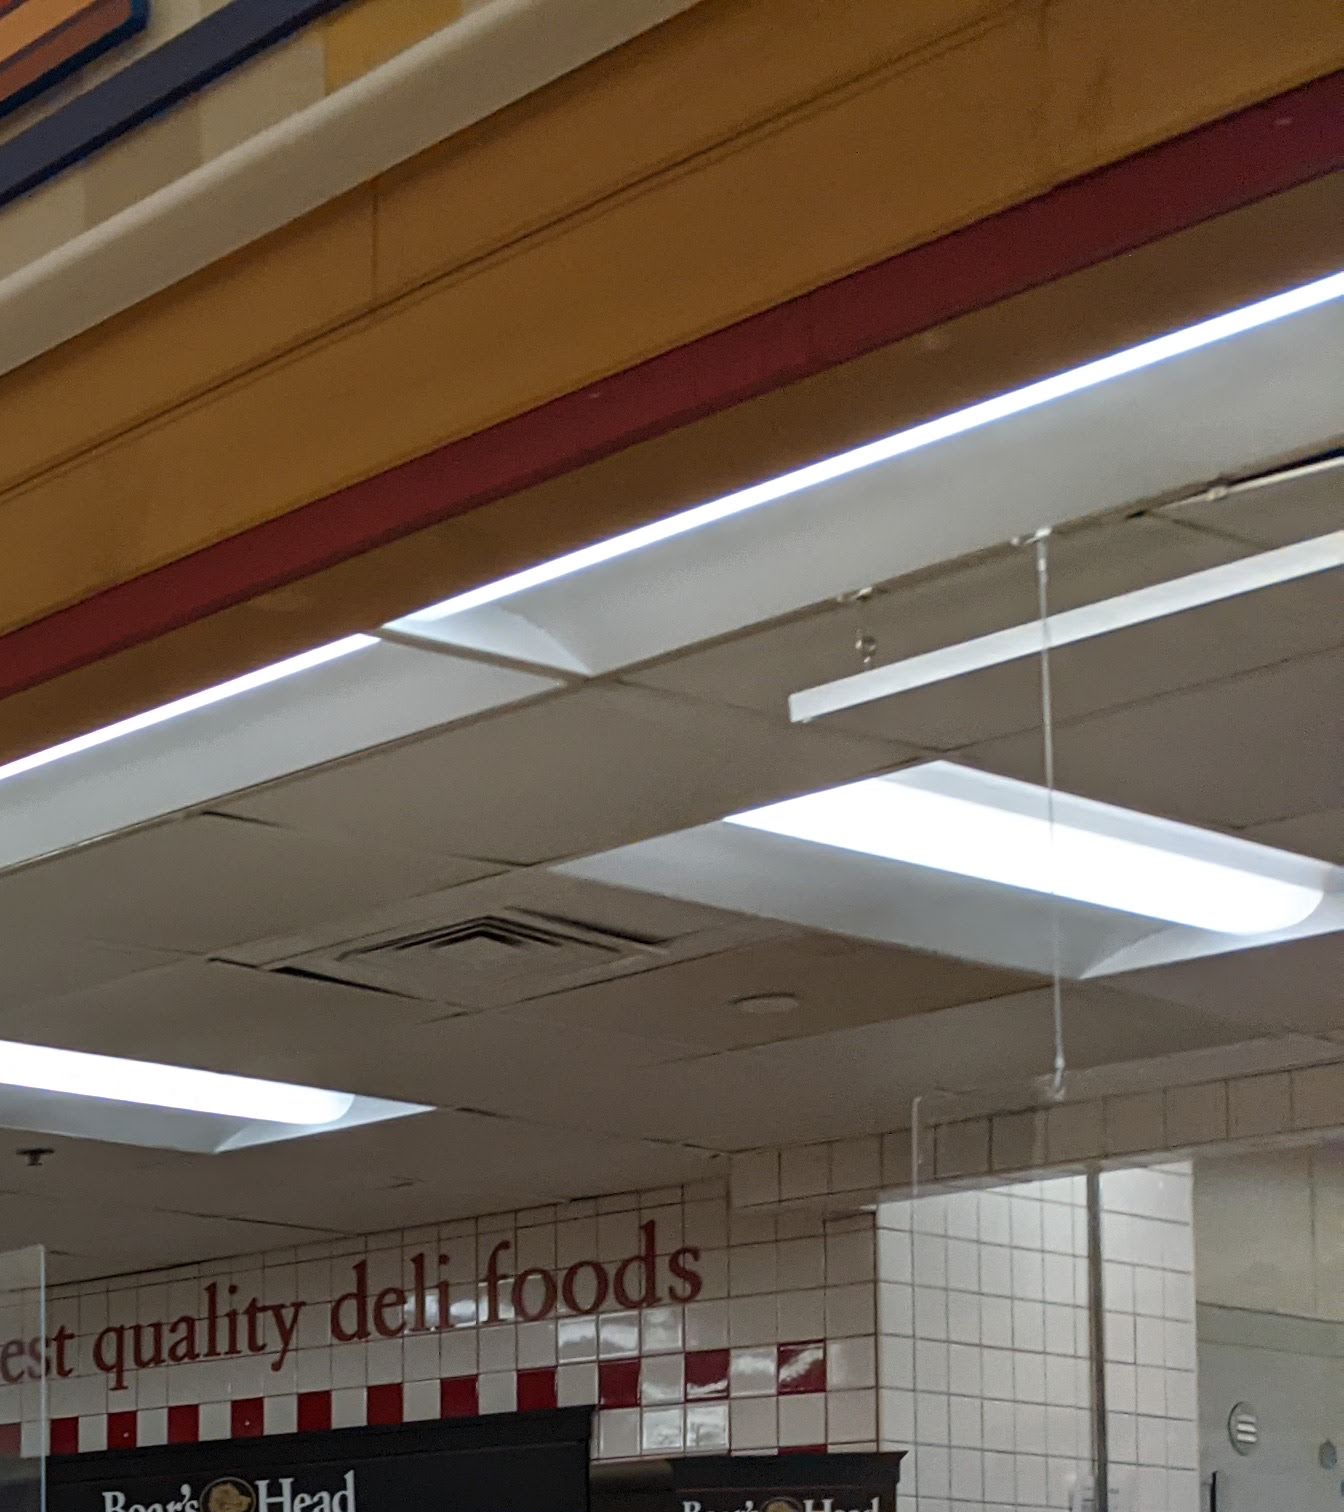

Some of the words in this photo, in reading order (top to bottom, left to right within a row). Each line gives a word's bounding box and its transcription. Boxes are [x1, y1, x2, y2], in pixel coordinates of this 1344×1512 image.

[92, 1282, 306, 1390] quality
[329, 1252, 453, 1342] deli
[478, 1221, 703, 1323] foods
